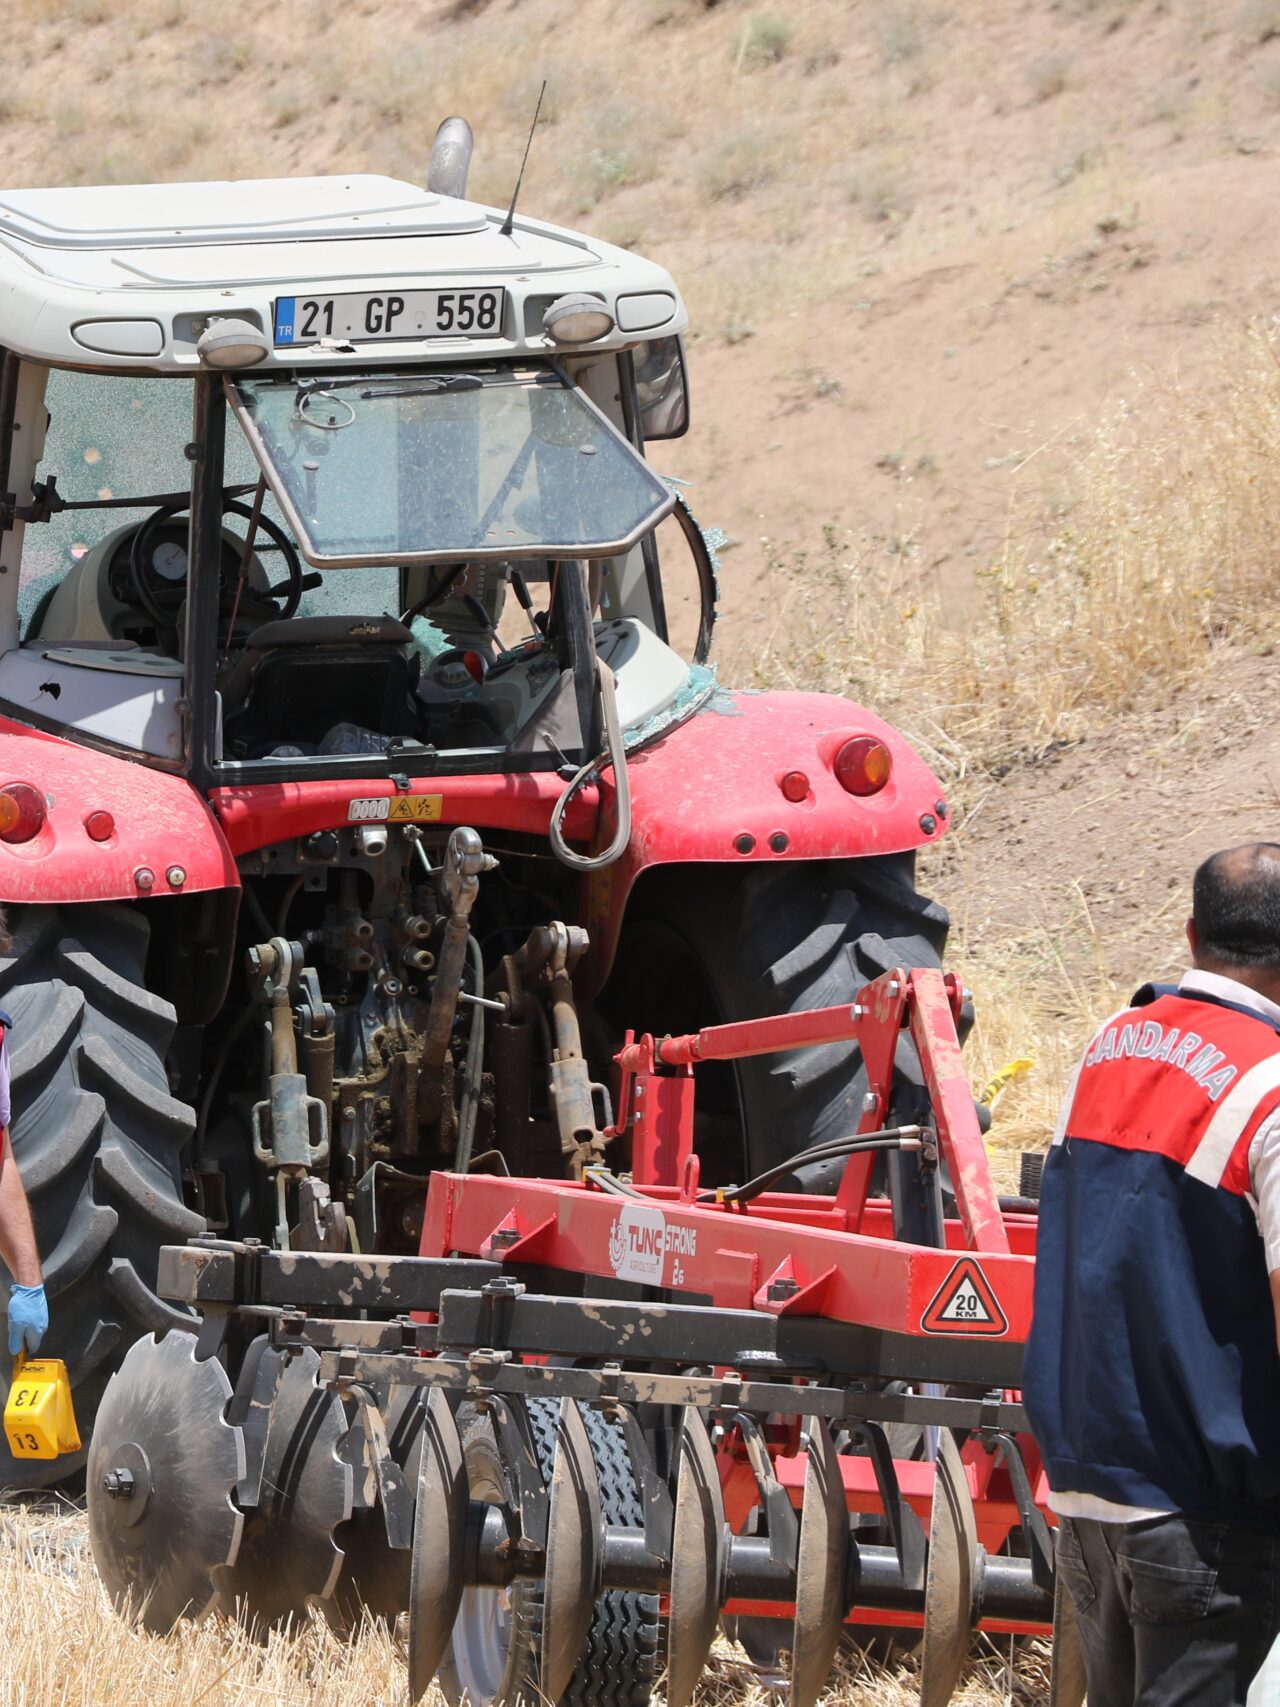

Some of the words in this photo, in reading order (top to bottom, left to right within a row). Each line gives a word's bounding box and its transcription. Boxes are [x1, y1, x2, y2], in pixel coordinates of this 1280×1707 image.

[301, 300, 334, 337] 21
[365, 296, 405, 334] GP
[436, 292, 497, 331] 558
[278, 325, 293, 336] TR
[1086, 1020, 1238, 1102] JANDARMA
[665, 1223, 697, 1256] STRONG
[955, 1294, 978, 1311] 20
[14, 1389, 40, 1407] 13
[12, 1433, 40, 1451] 13
